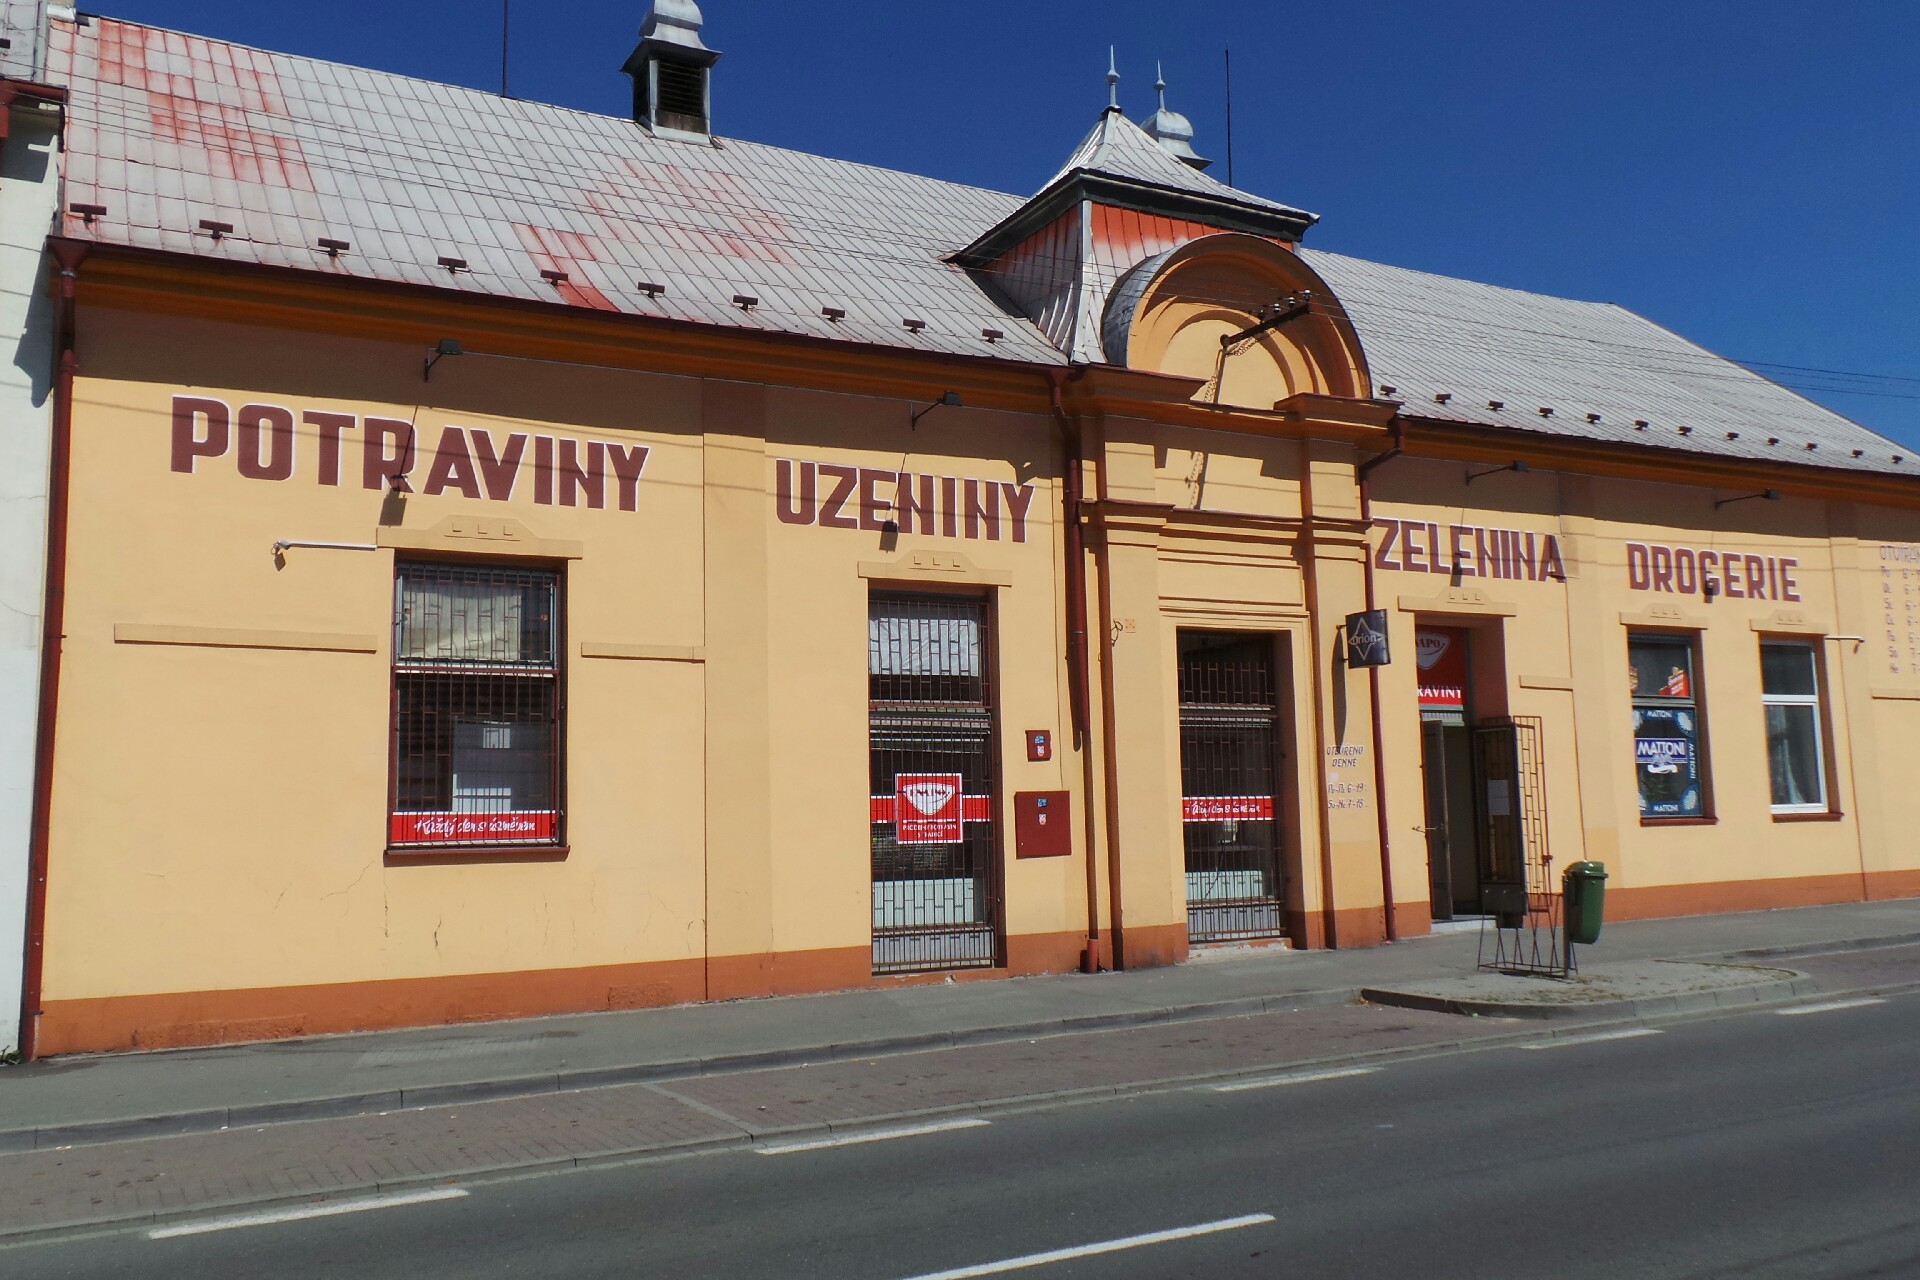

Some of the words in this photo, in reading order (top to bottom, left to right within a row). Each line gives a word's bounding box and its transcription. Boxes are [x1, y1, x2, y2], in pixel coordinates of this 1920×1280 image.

[171, 395, 650, 512] POTRAVINY
[776, 459, 1035, 543] UZENINY
[1372, 516, 1566, 583] ZELENINA
[1626, 542, 1801, 602] DROGERIE
[1637, 741, 1685, 756] MATTONI
[414, 817, 457, 837] Každý
[458, 818, 476, 832] den
